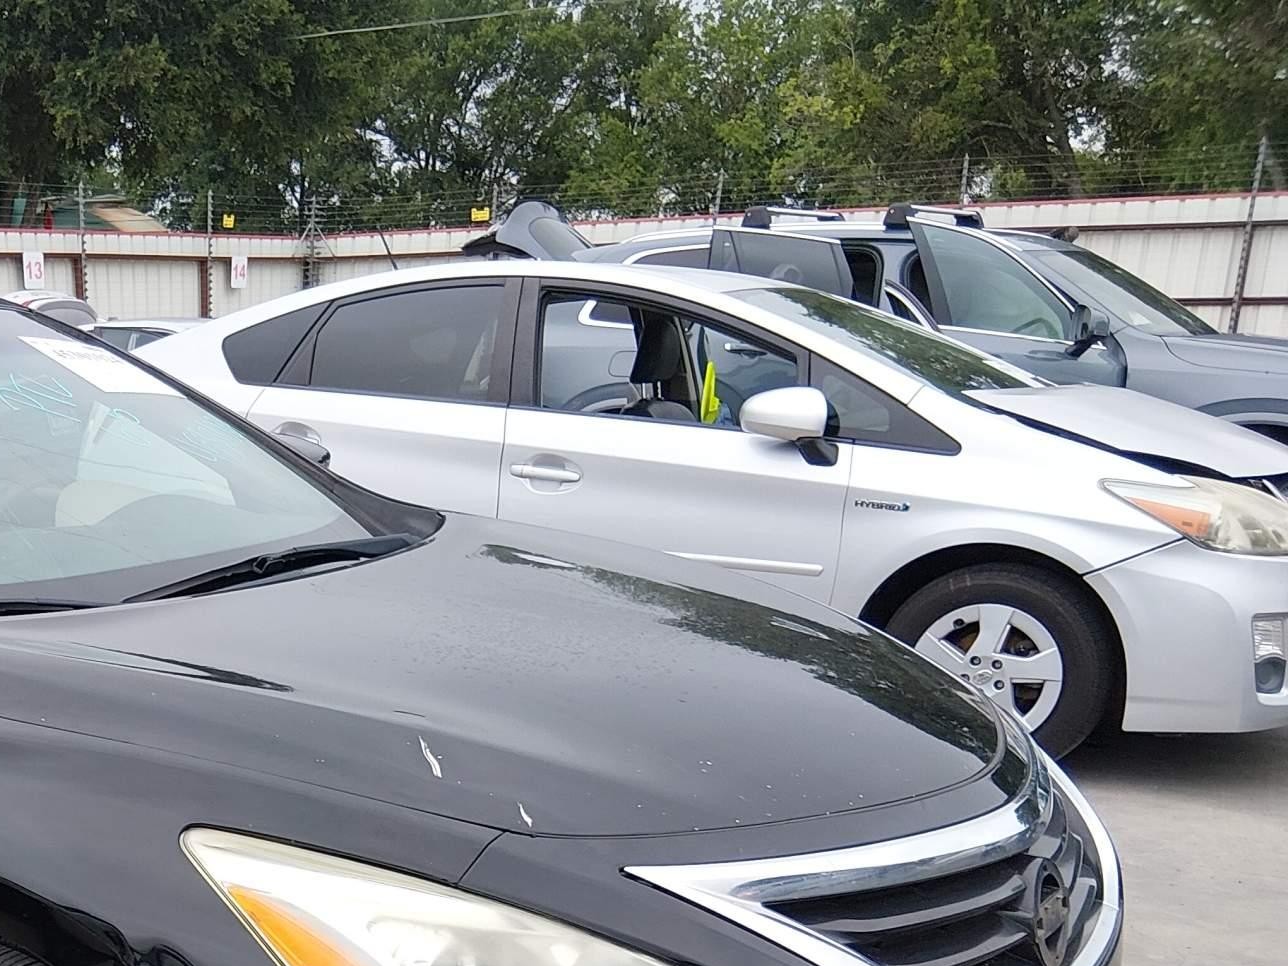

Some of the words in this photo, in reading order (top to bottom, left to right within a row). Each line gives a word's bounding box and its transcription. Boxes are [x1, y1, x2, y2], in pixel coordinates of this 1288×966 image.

[26, 261, 42, 279] 13
[233, 263, 245, 280] 14
[854, 499, 901, 512] HYBRID
